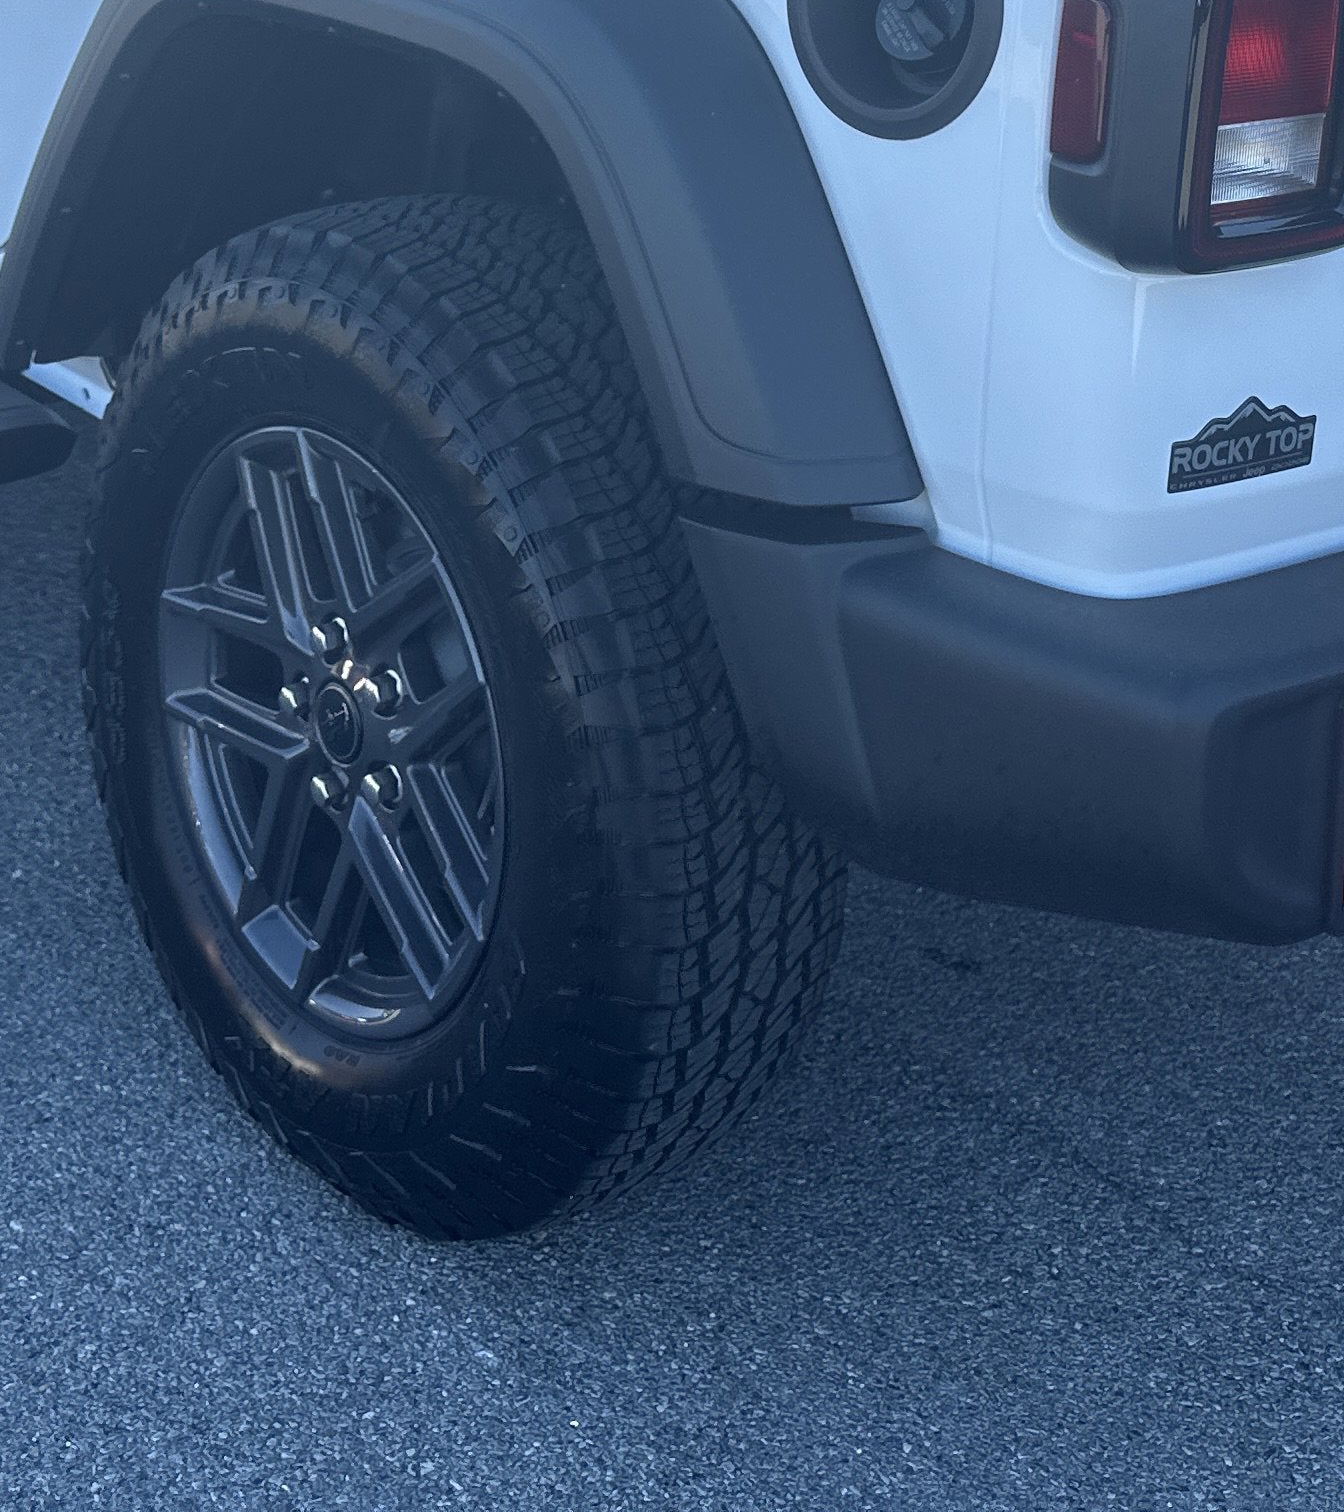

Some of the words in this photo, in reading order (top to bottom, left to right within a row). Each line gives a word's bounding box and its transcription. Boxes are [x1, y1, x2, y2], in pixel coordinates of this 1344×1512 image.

[1171, 433, 1262, 474] ROCKY
[1266, 423, 1314, 455] TOP
[1242, 465, 1266, 478] Jeep
